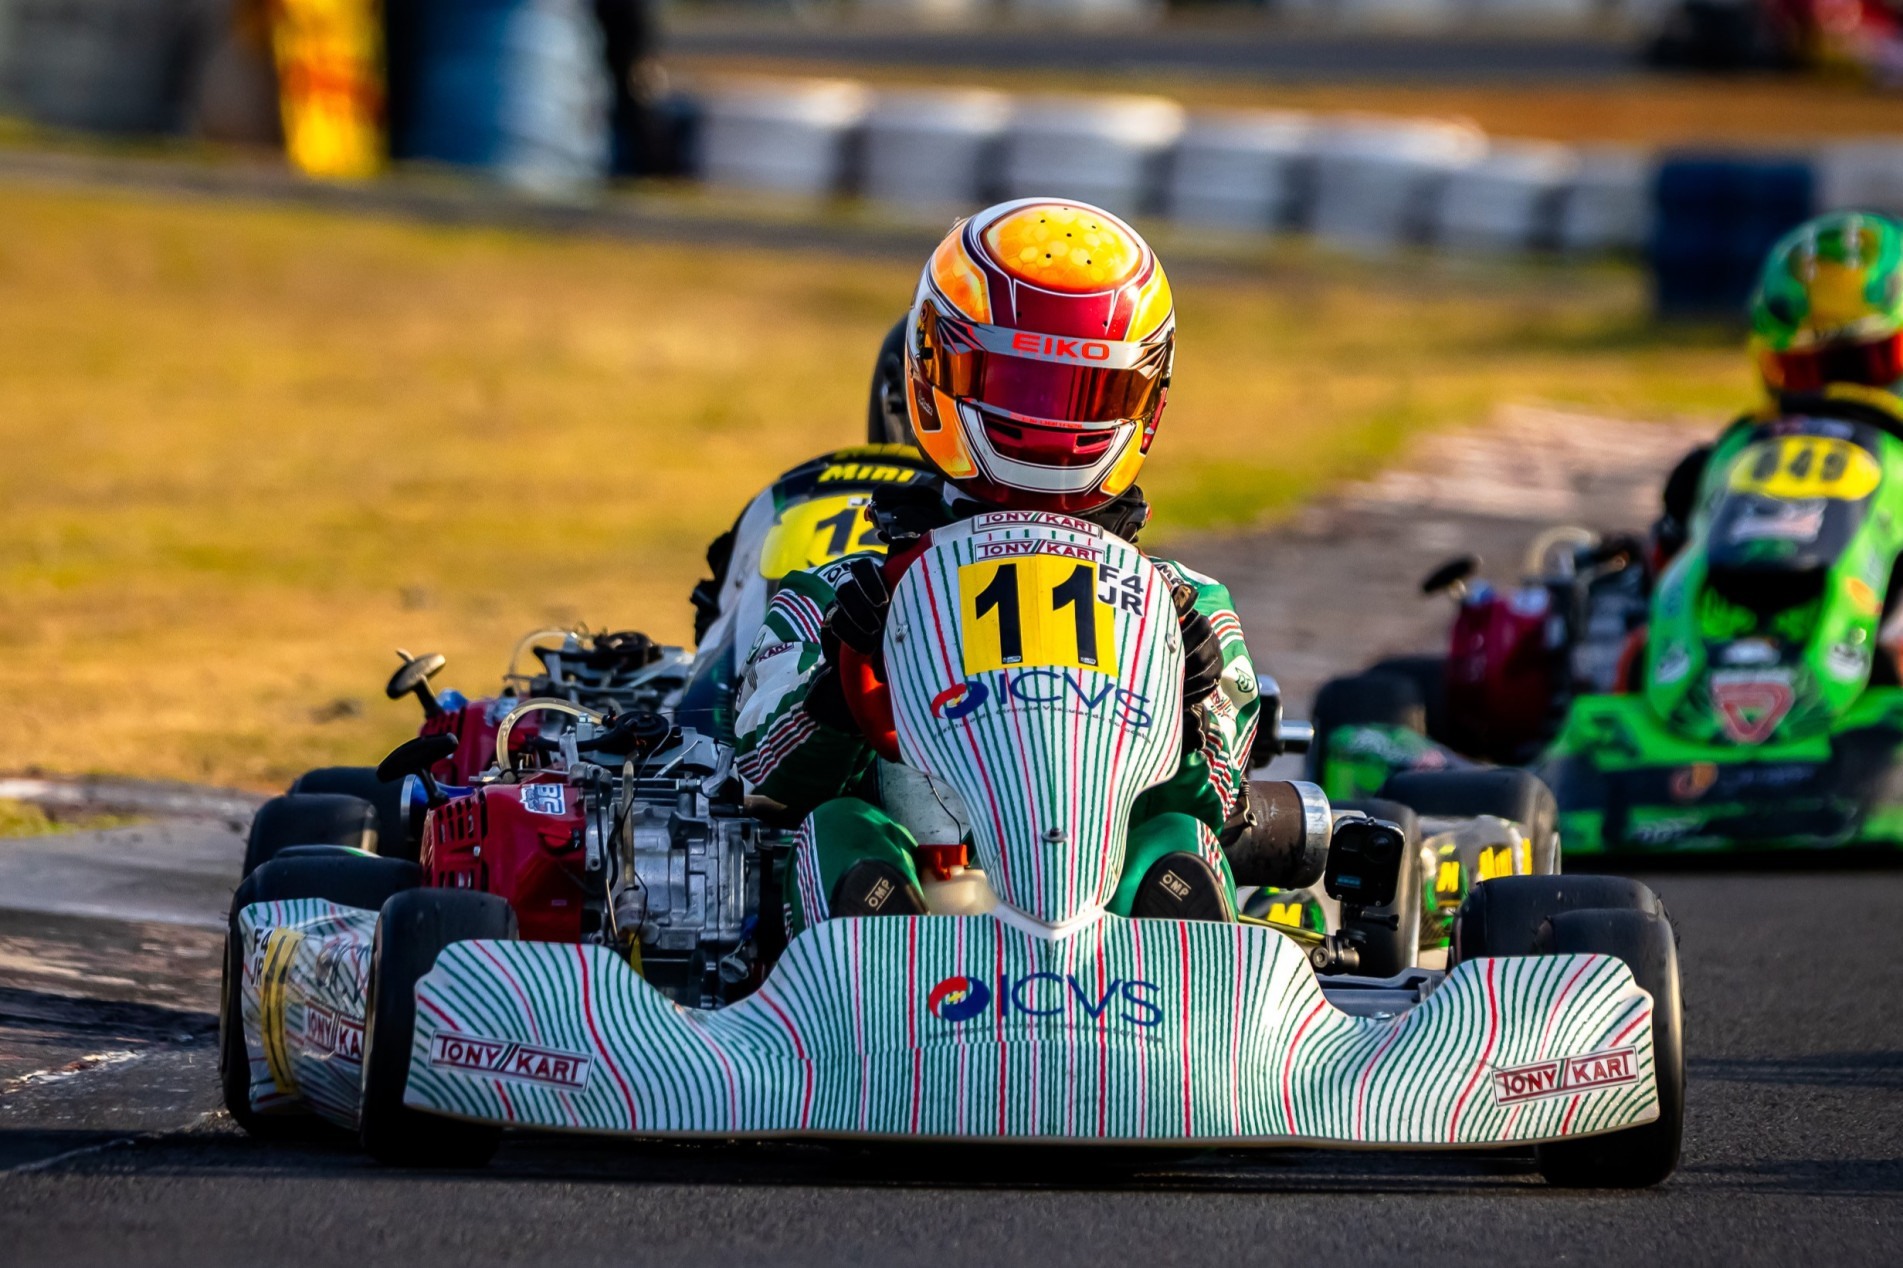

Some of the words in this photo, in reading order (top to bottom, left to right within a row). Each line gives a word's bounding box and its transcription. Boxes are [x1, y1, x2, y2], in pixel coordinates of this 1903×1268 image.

[1011, 332, 1110, 361] EIKO
[985, 512, 1032, 523] TONY
[1045, 513, 1095, 533] KART
[978, 541, 1034, 556] TONY
[1046, 543, 1101, 562] KART
[1098, 562, 1144, 595] F4
[975, 563, 1099, 667] 11
[1097, 586, 1143, 617] JR
[999, 670, 1153, 728] ICVS
[868, 878, 890, 908] OMP
[1162, 873, 1190, 897] OMP
[1001, 972, 1163, 1028] ICVS
[338, 1026, 364, 1059] KA
[436, 1035, 503, 1068] TONY
[516, 1050, 588, 1082] KART
[1496, 1066, 1557, 1097] TONY
[1572, 1051, 1634, 1084] KART
